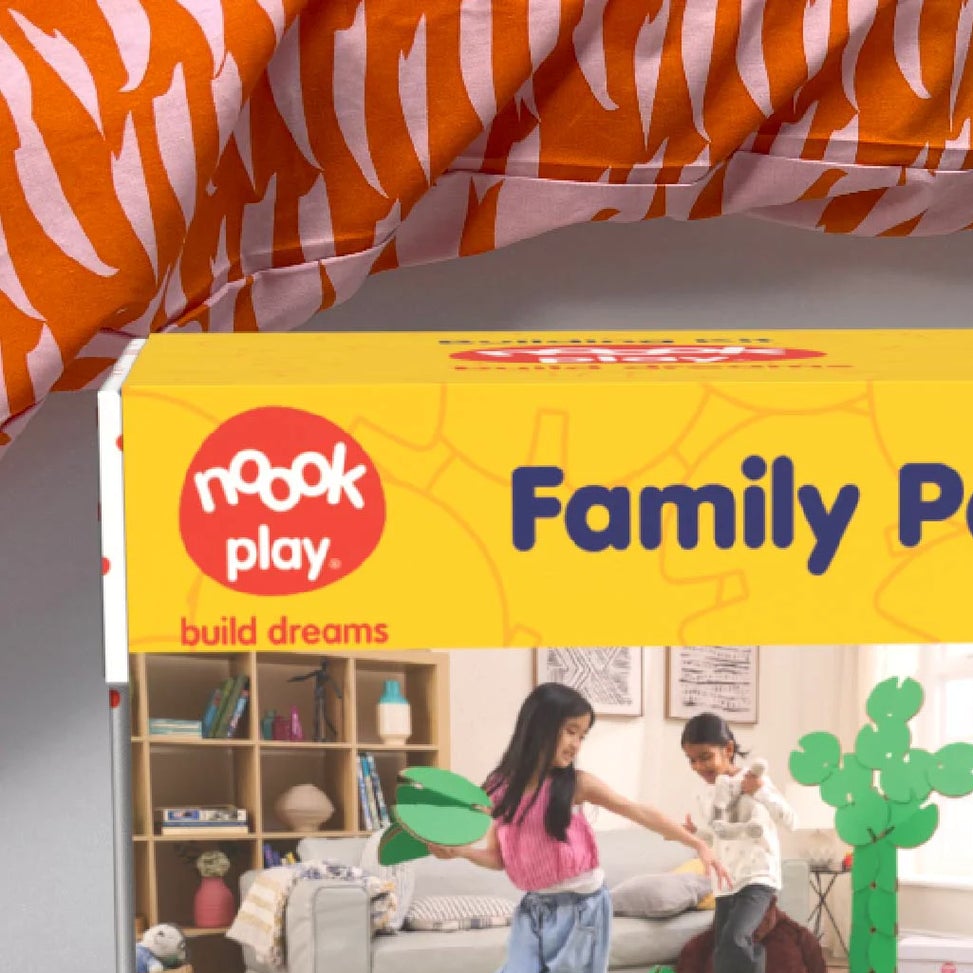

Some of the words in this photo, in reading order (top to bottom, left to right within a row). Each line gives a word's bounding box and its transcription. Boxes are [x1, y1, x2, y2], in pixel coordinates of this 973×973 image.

[512, 455, 860, 576] Family
[180, 615, 257, 647] build
[267, 615, 389, 646] dreams
